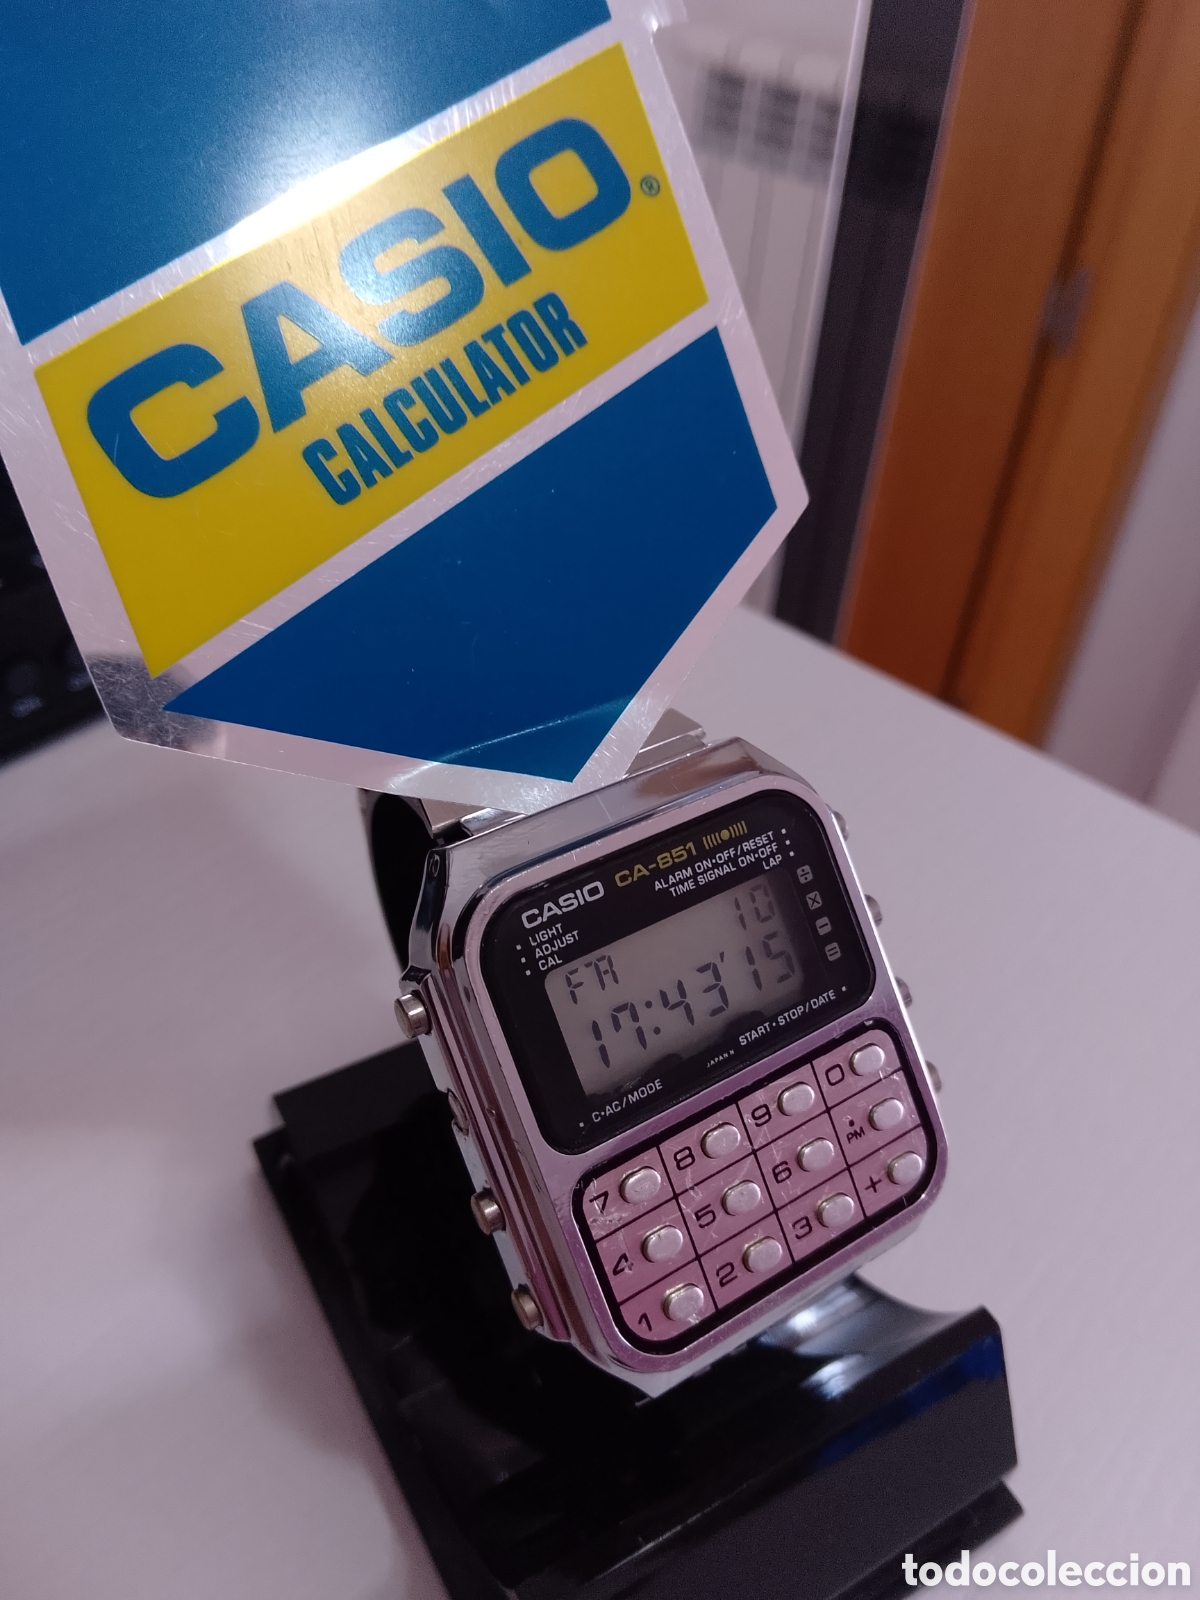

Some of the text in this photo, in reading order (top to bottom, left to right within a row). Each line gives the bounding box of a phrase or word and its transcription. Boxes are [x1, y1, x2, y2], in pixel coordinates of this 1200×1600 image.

[87, 117, 632, 499] CASIO
[301, 291, 588, 506] CALCULATOR
[762, 854, 783, 871] LAP
[521, 841, 697, 929] CASIO CA-851
[654, 867, 693, 891] ALARM
[669, 880, 696, 898] TIME
[697, 865, 737, 886] SIGNAL
[528, 922, 563, 947] LIGHT
[534, 930, 580, 959] ADJUST
[538, 953, 563, 971] CAL
[706, 1053, 729, 1068] JAPAN
[824, 1063, 845, 1086] 0
[751, 1103, 772, 1128] 9
[846, 1126, 866, 1144] PM
[673, 1146, 696, 1171] 8
[771, 1160, 793, 1184] 6
[589, 1191, 610, 1214] 7
[695, 1203, 717, 1228] 5
[794, 1216, 813, 1240] 3
[612, 1253, 633, 1276] 4
[715, 1262, 738, 1287] 2
[638, 1312, 654, 1332] 1
